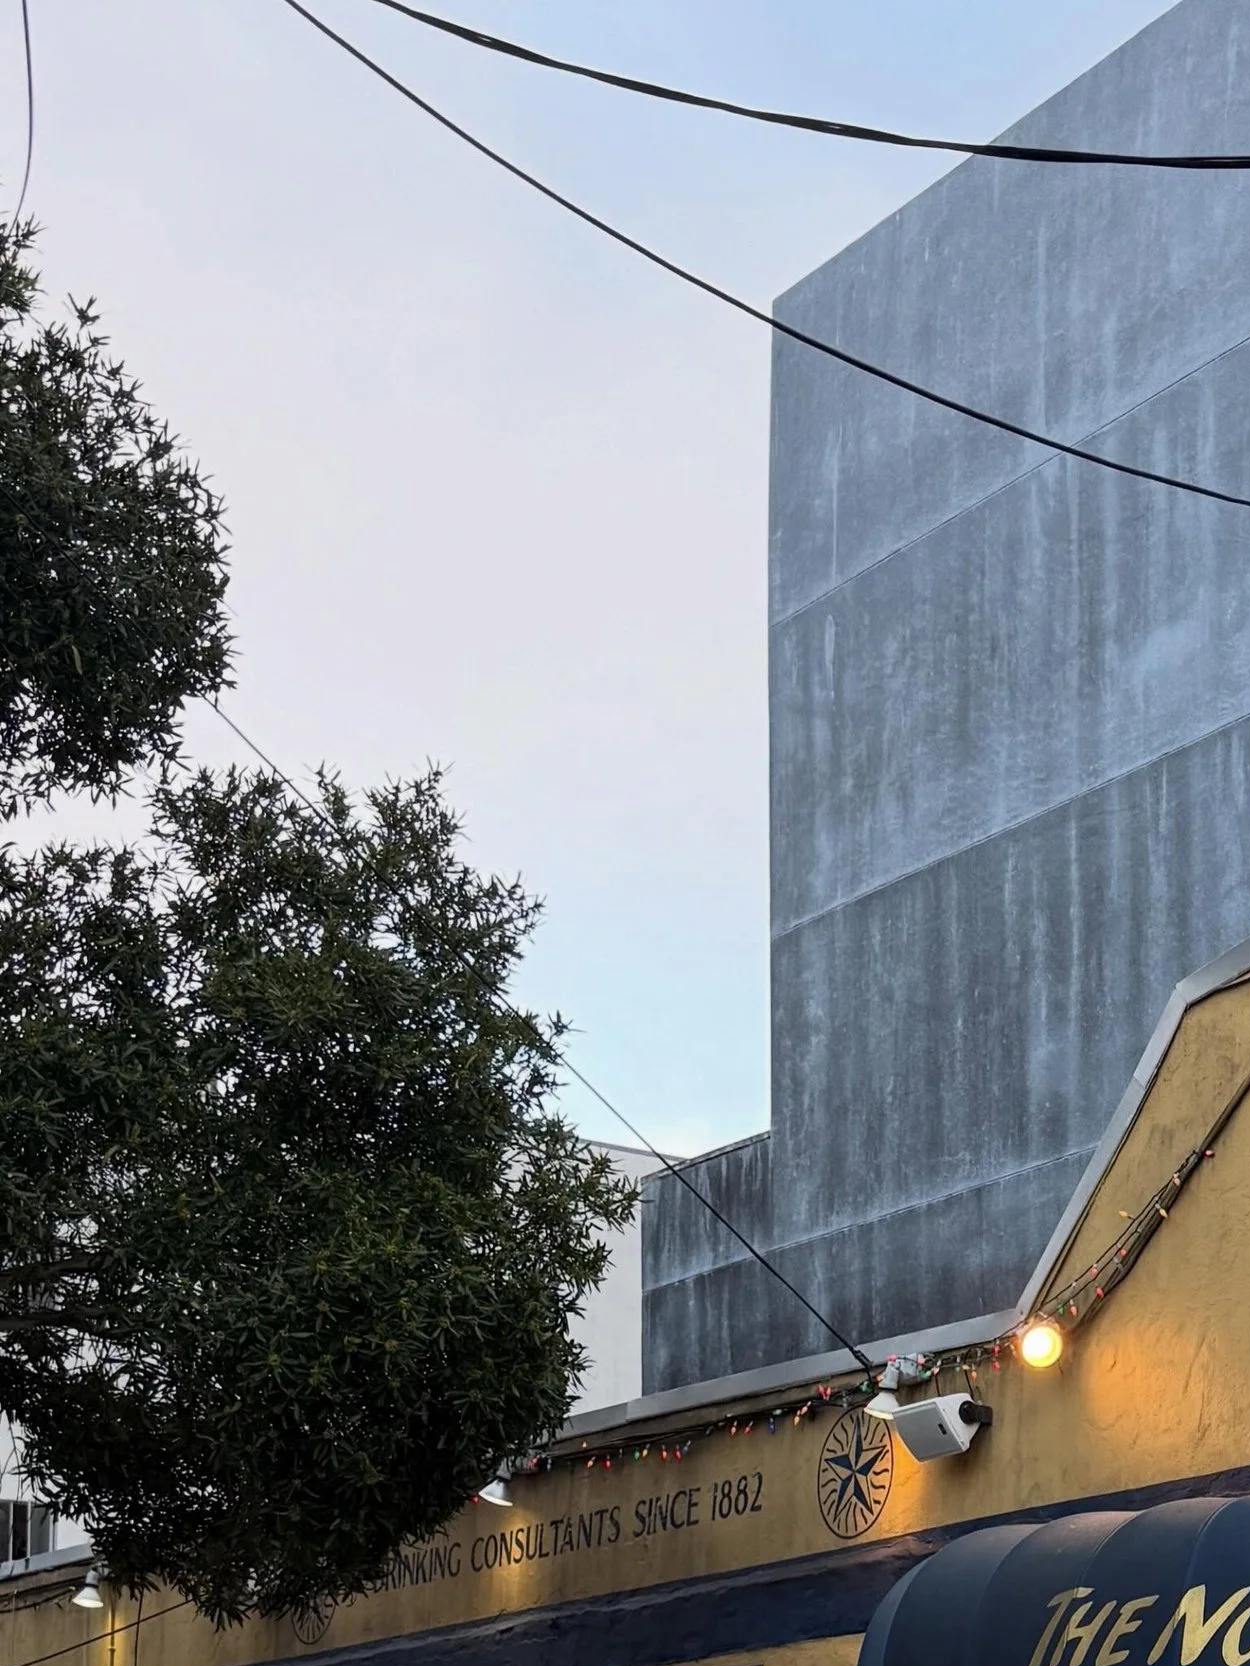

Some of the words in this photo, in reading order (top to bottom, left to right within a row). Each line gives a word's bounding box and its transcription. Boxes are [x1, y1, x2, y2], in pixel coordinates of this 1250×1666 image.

[470, 1505, 621, 1573] CONSULTANTS
[632, 1486, 702, 1538] SINCE
[710, 1471, 764, 1522] 1882
